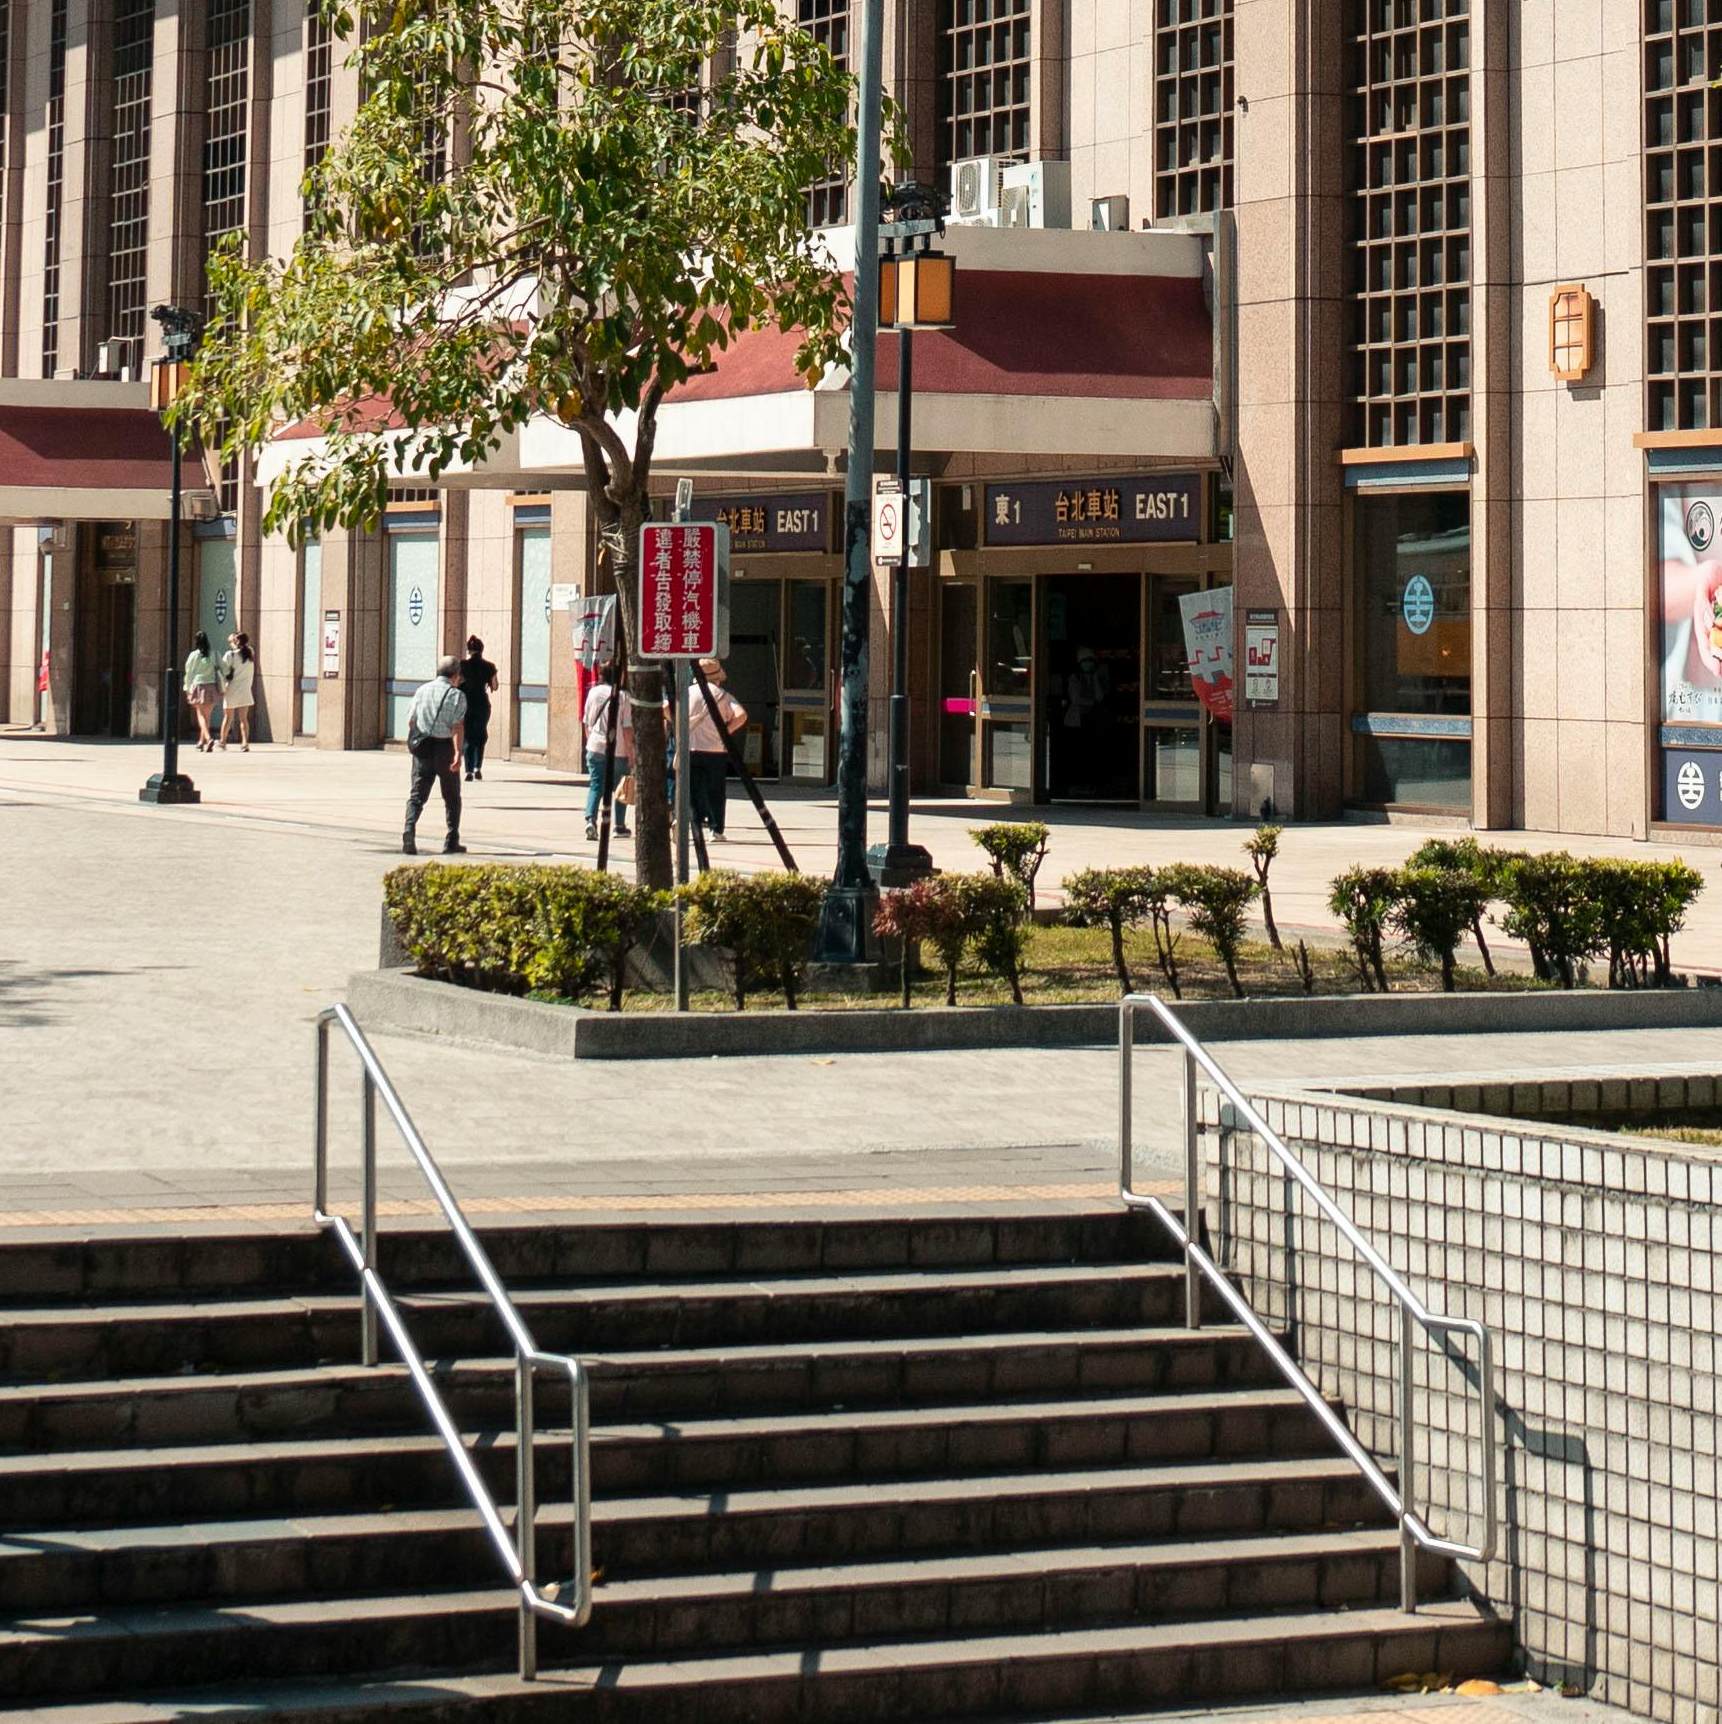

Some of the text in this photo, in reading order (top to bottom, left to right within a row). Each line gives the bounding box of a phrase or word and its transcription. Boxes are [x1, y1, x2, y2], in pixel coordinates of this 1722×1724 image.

[777, 510, 809, 533] EAST
[1055, 489, 1119, 522] 台北車站
[1136, 493, 1177, 519] EAST
[652, 528, 673, 652] 違者告發取締
[682, 528, 702, 652] 嚴禁停汽機車
